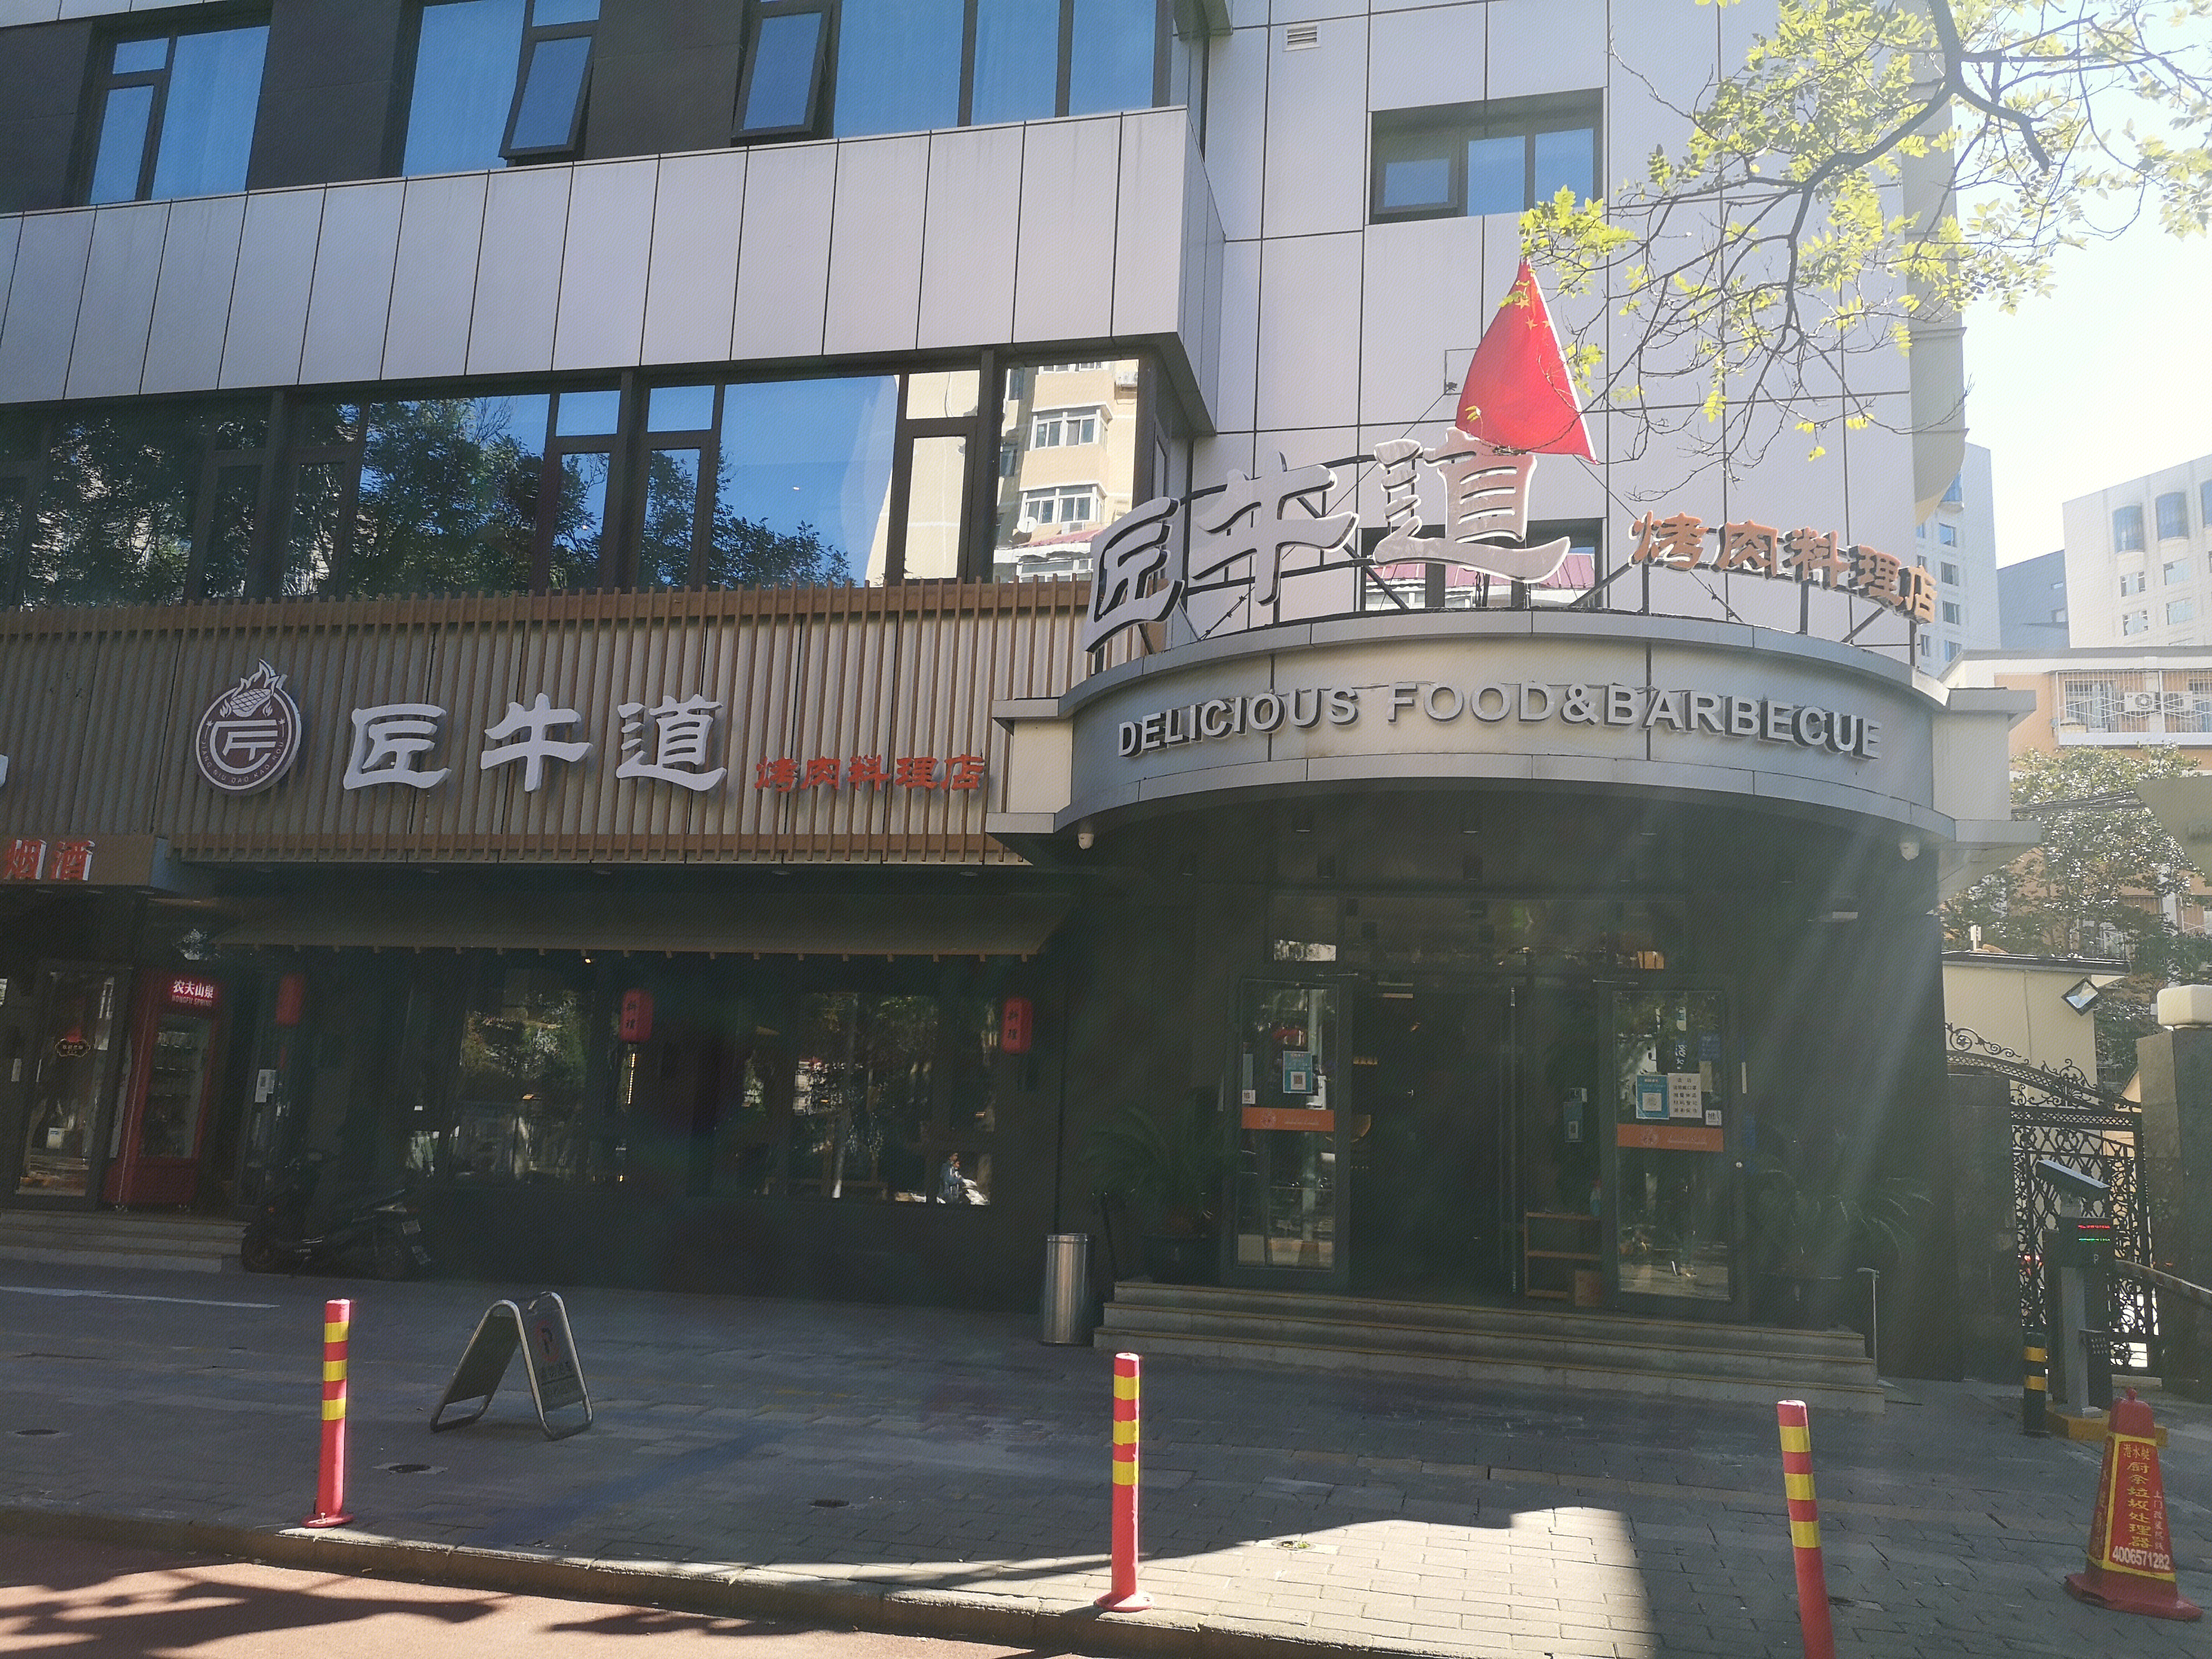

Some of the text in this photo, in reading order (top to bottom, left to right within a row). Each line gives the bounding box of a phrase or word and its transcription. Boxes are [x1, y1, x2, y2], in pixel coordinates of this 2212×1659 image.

[1085, 427, 1570, 653] 匠牛道
[1630, 511, 1938, 625] 烤肉料理店
[343, 693, 727, 792] 匠牛道
[1118, 686, 1359, 758] DELICIOUS
[201, 741, 212, 768] JIANG
[213, 769, 226, 781] NIU
[254, 764, 270, 778] KAO
[272, 741, 284, 761] ROU
[754, 754, 986, 792] 烤肉料理店
[2, 839, 95, 881] 烟酒
[173, 979, 214, 999] 农夫山泉
[2123, 1443, 2151, 1461] 潜水艇
[2126, 1462, 2153, 1549] 厨余垃圾处理器
[2112, 1545, 2170, 1571] 4006571282
